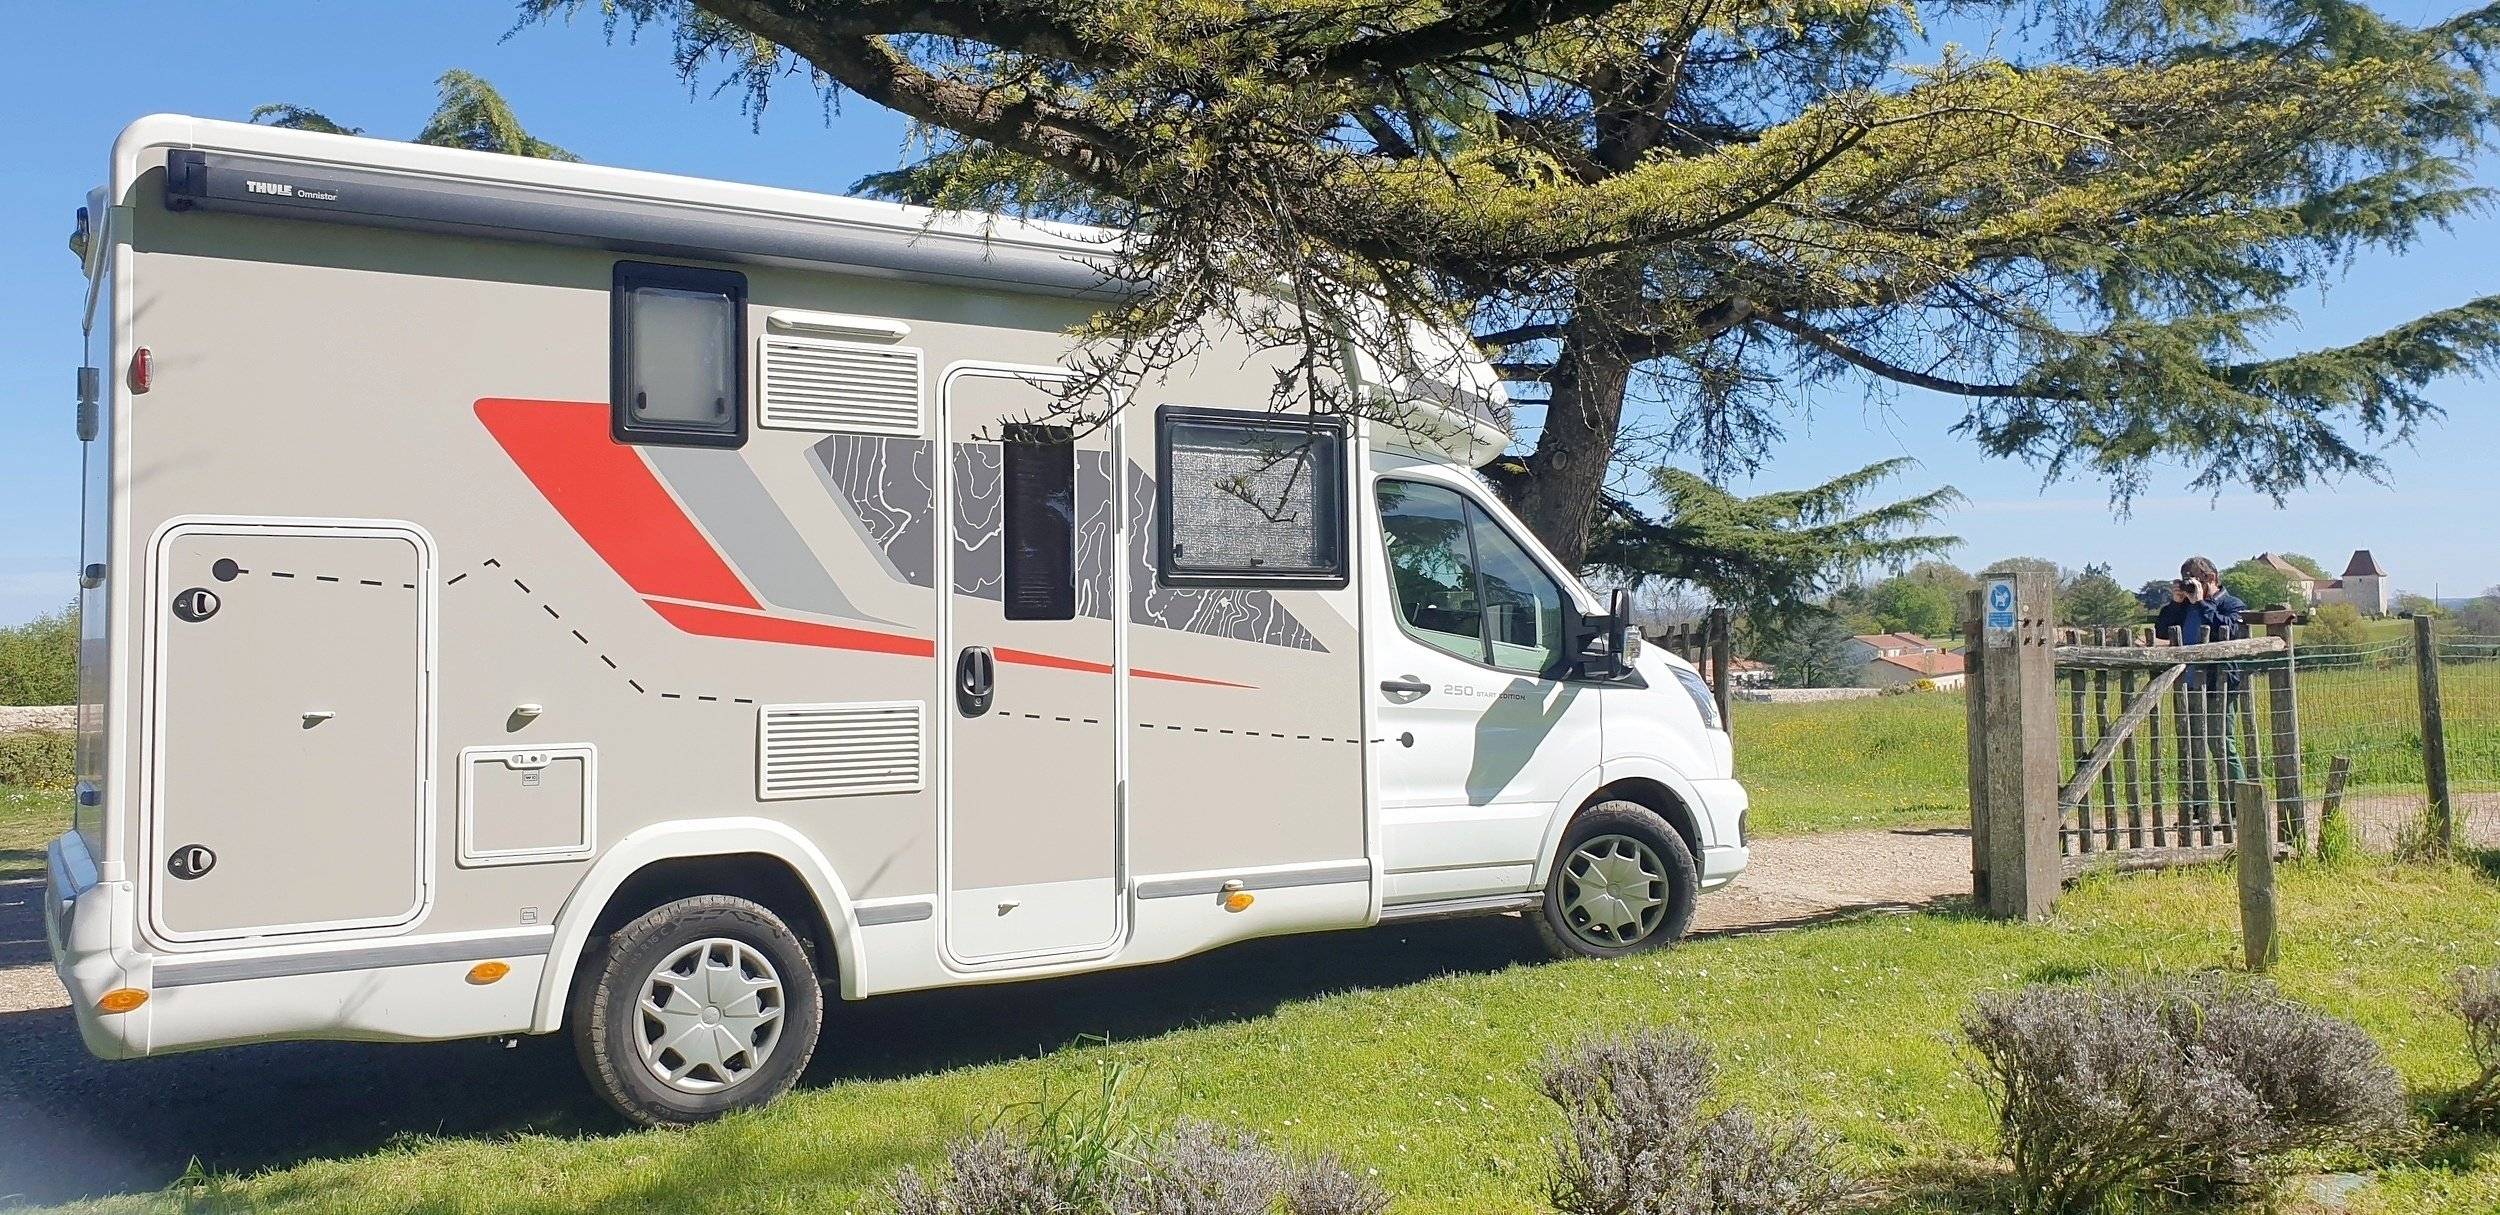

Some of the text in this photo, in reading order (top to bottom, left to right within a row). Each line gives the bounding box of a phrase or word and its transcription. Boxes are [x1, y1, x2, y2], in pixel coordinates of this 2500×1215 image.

[246, 180, 338, 201] THULE Omnistor
[1443, 684, 1474, 696] 250
[1476, 690, 1496, 699] START
